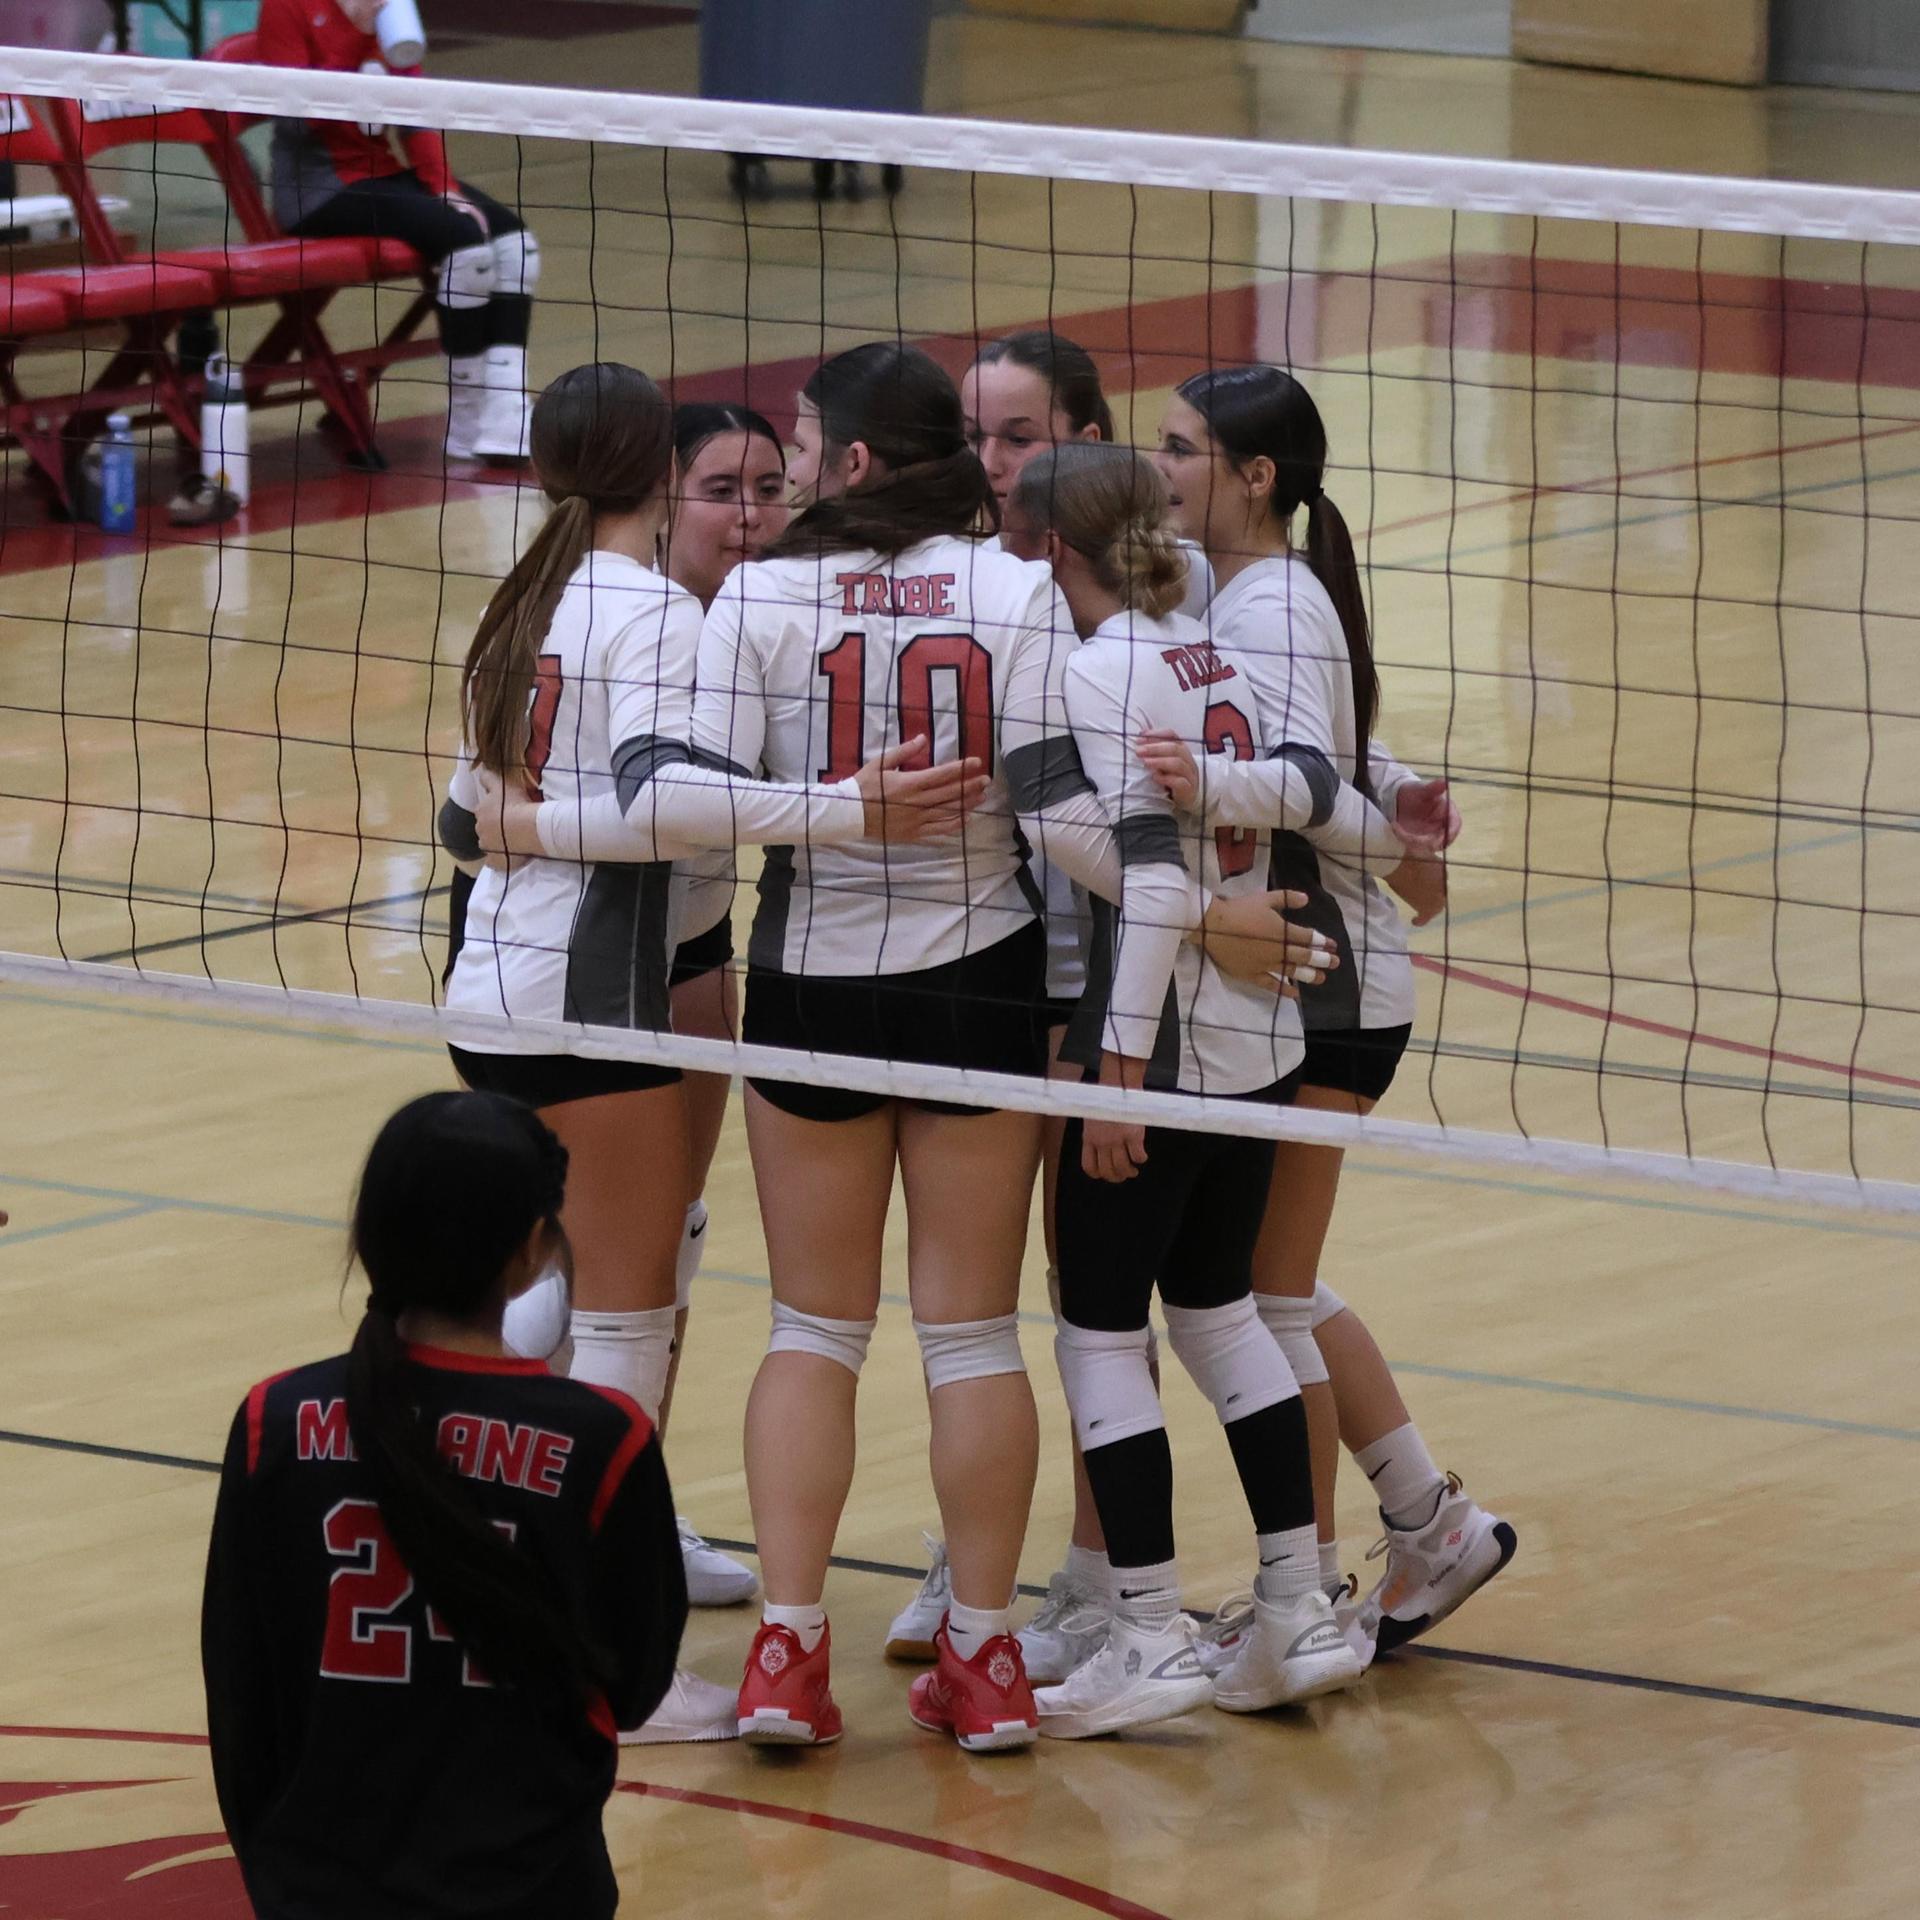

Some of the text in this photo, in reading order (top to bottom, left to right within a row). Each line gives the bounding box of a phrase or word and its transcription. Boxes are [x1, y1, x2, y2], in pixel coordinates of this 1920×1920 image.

[836, 572, 955, 617] TRIBE
[817, 632, 994, 785] 10
[297, 1398, 574, 1498] MANE
[319, 1497, 516, 1687] 2
